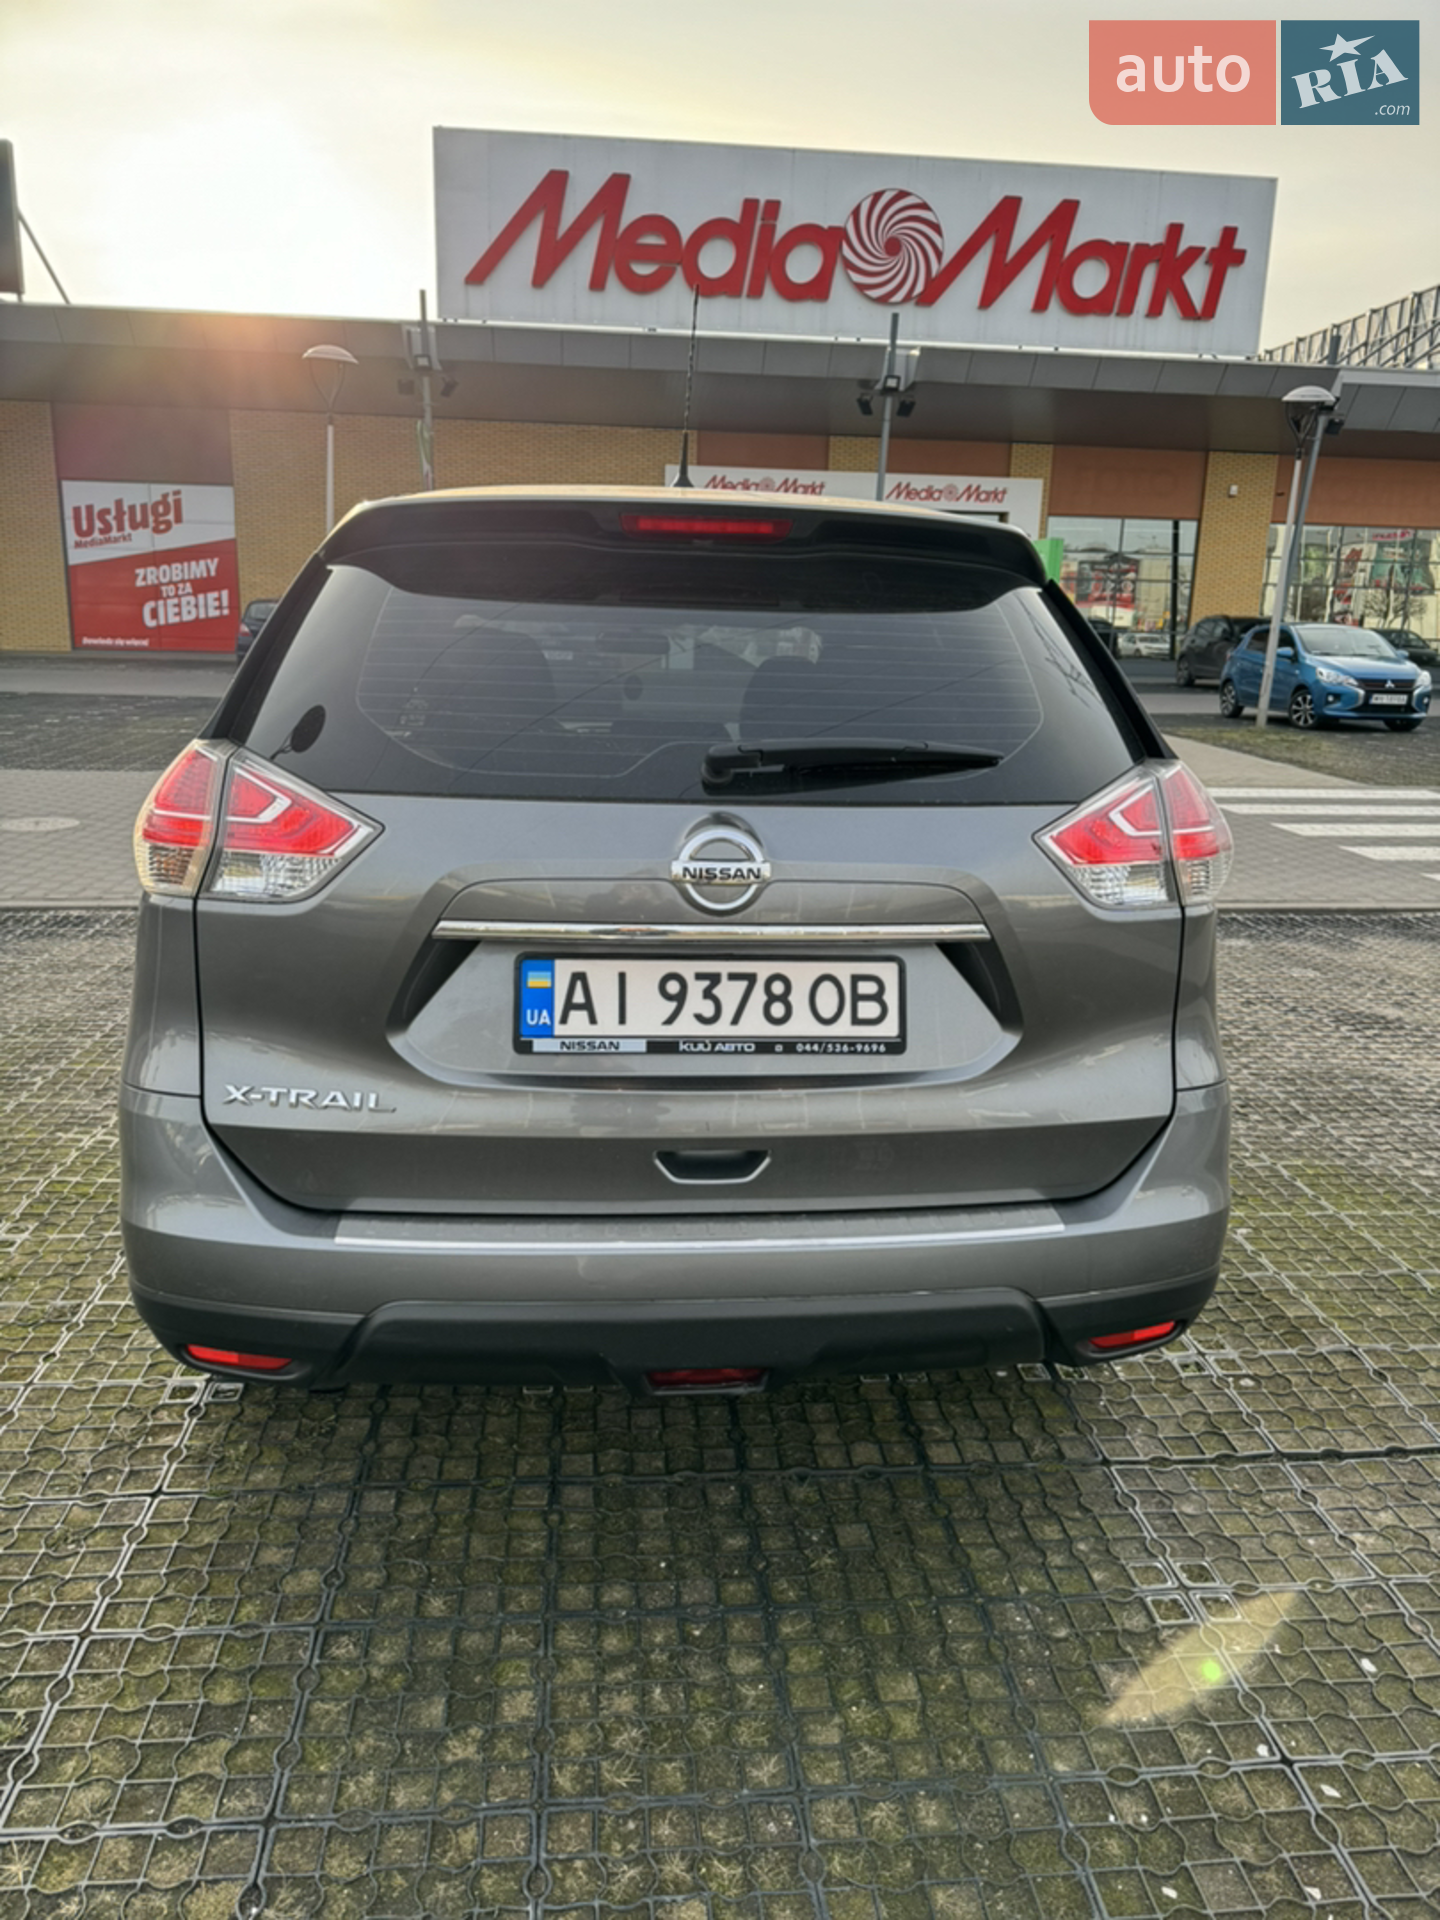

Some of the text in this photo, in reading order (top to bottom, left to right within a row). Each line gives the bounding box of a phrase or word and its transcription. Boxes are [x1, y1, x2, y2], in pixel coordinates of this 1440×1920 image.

[464, 168, 1248, 320] Media Markt
[776, 477, 826, 496] Markt
[886, 481, 1007, 504] Media Markt
[72, 489, 184, 538] Usługi
[74, 533, 132, 549] MediaMarkt
[135, 557, 219, 588] ZROBIMY
[160, 582, 193, 598] TO ZA
[142, 589, 229, 629] CIEBIE!
[682, 866, 762, 881] NISSAN
[526, 1008, 551, 1026] UA
[658, 971, 793, 1027] 9378
[808, 972, 889, 1027] OB
[559, 1040, 620, 1051] NISSAN
[796, 1042, 887, 1053] 044/536-9696
[223, 1084, 397, 1113] X-TRAIL
